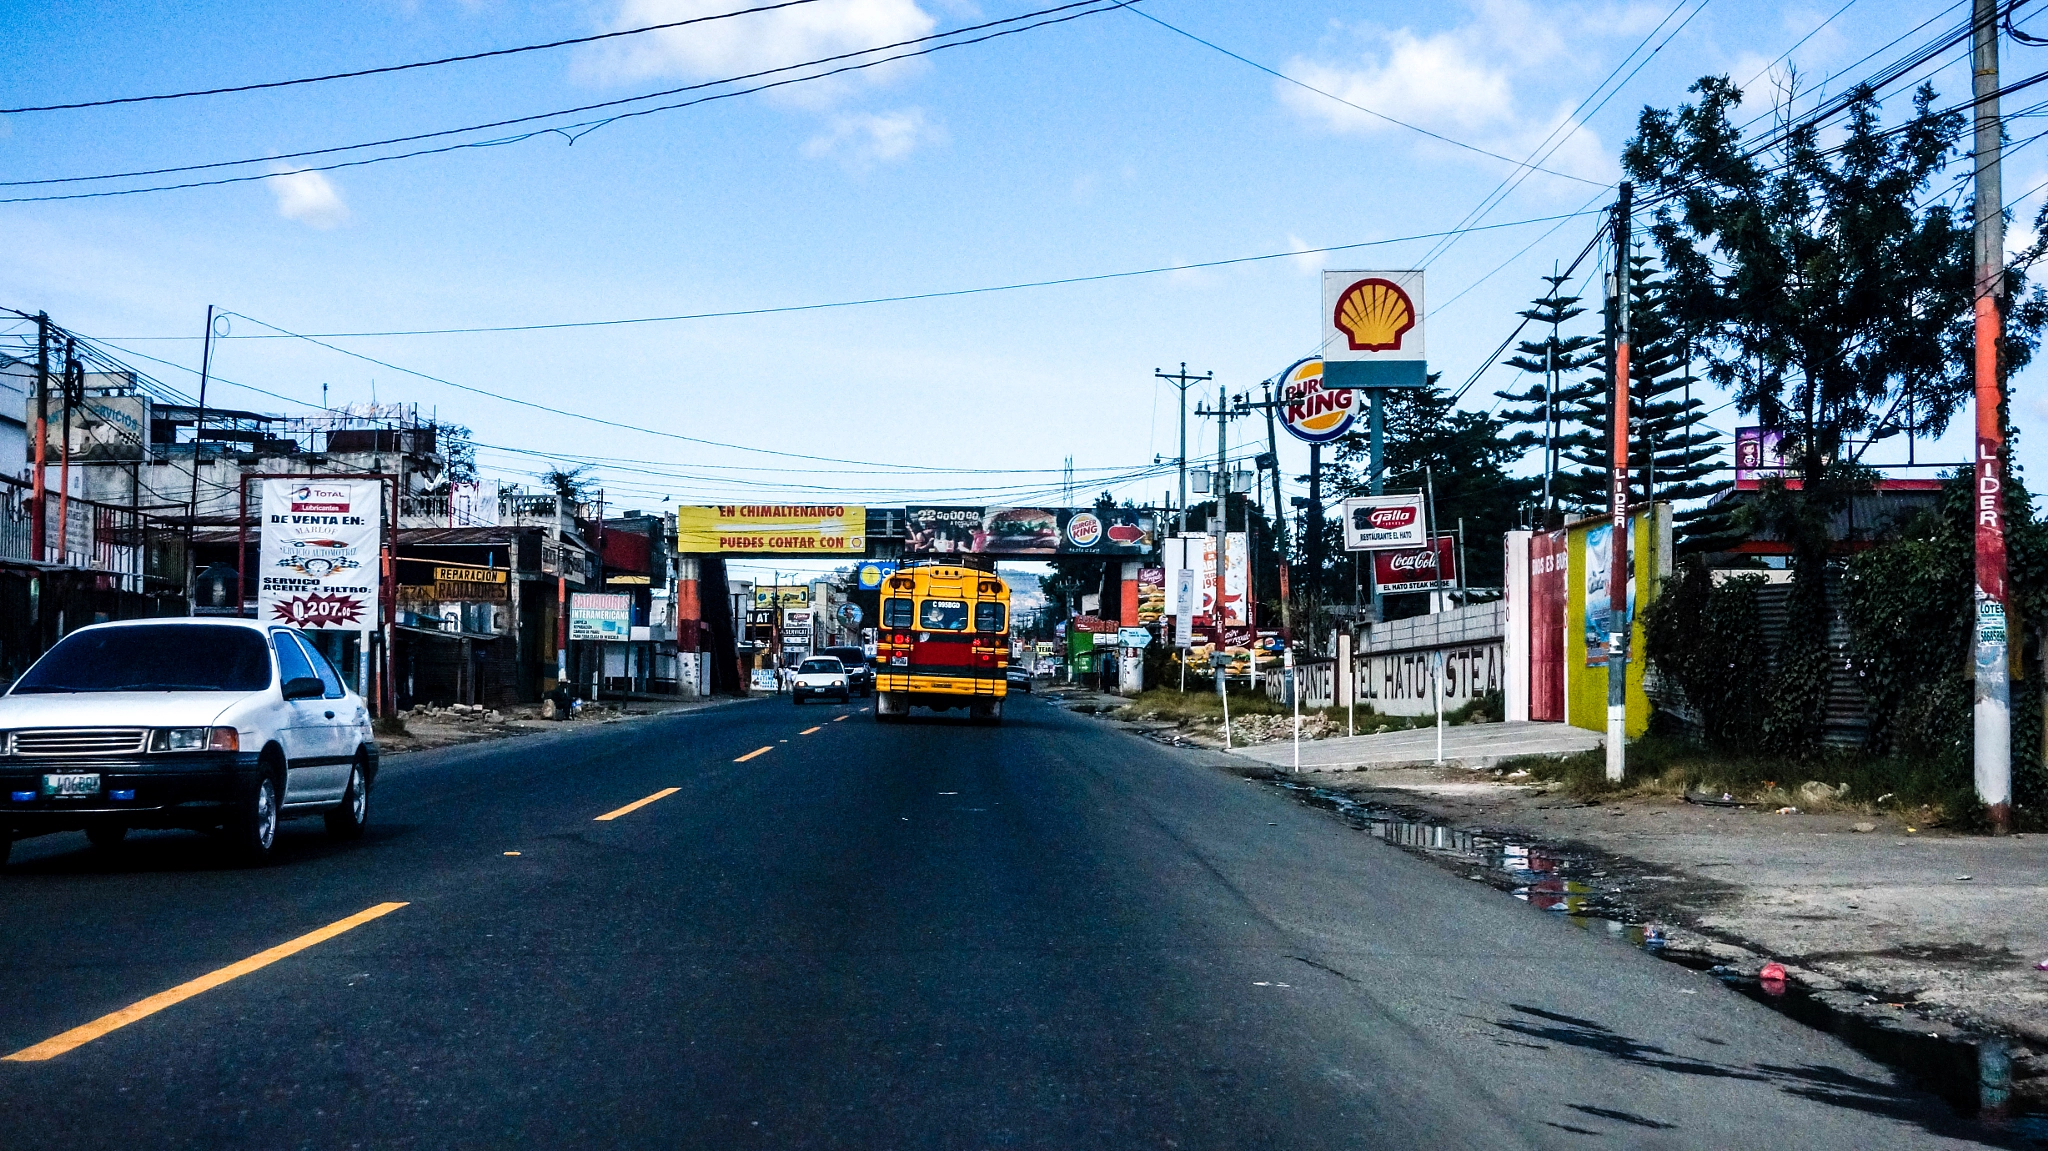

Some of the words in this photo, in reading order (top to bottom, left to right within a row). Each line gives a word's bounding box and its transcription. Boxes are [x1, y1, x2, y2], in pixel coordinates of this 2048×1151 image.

[1285, 377, 1324, 401] BUR
[1288, 389, 1353, 424] KING
[1979, 443, 2000, 527] LIDER
[314, 489, 345, 498] TOTAL
[301, 504, 340, 512] Lubricantes
[719, 506, 735, 517] EN
[740, 505, 845, 517] CHIMALTENANGO
[271, 514, 289, 524] DE
[292, 515, 339, 525] VENTA
[342, 516, 365, 526] EN:
[1370, 510, 1411, 525] Gallo
[1072, 520, 1097, 531] BURGER
[1073, 525, 1098, 538] KING
[1360, 532, 1392, 541] RESTAURANTE
[1393, 532, 1399, 540] EL
[1400, 531, 1412, 539] HATO
[719, 537, 764, 549] PUEDES
[768, 536, 815, 548] CONTAR
[819, 536, 844, 548] CON
[312, 547, 358, 557] AUTOMOTRIZ
[1545, 554, 1555, 573] ES
[440, 568, 498, 581] REPARACION
[263, 577, 321, 586] SERVICO
[1409, 581, 1429, 589] STEAK
[1430, 580, 1450, 588] HOSE
[262, 584, 309, 592] ACEITE
[323, 586, 372, 594] FILTRO:
[573, 594, 630, 610] RADIADORES
[572, 610, 629, 620] INTERAMERICANA
[1980, 604, 2005, 614] LOTES
